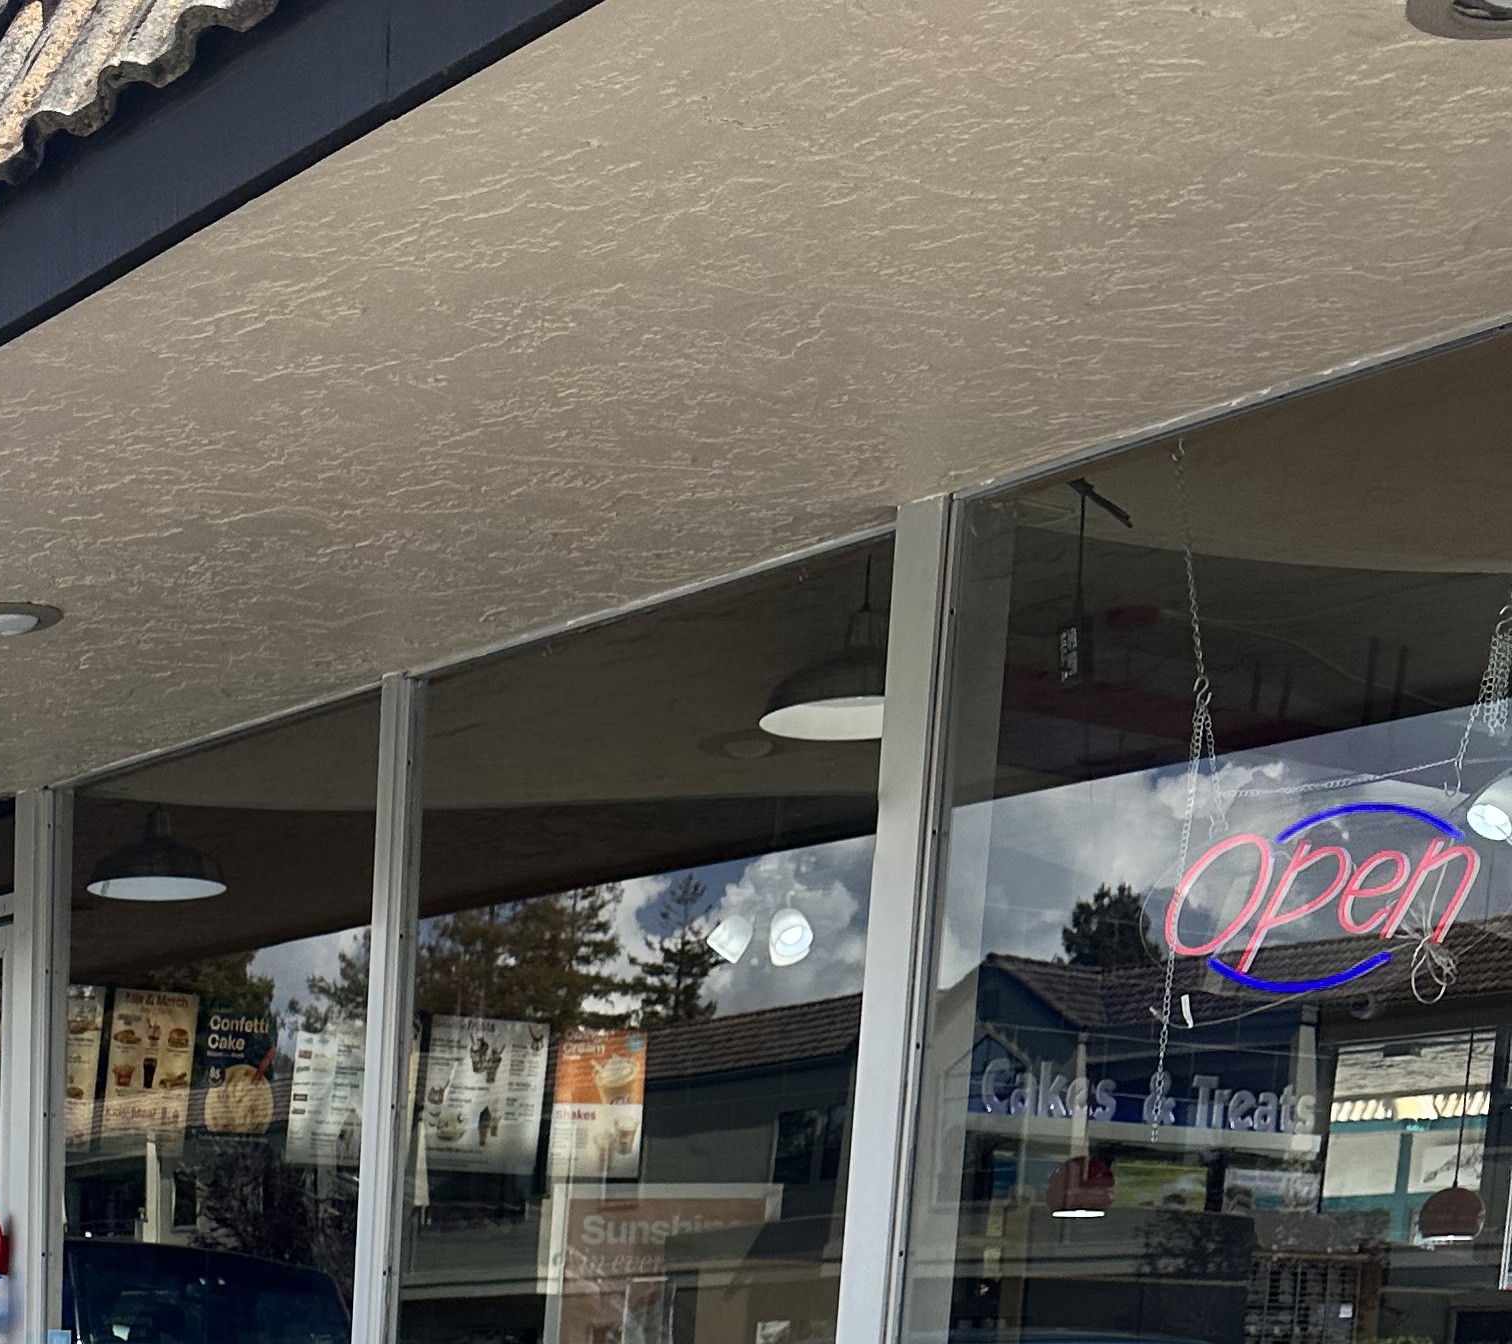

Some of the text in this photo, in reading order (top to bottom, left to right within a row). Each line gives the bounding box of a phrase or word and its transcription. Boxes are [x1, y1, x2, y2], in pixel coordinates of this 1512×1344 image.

[1165, 833, 1480, 976] Open
[209, 1014, 270, 1034] Confetti
[207, 1033, 246, 1051] Cake
[982, 1059, 1318, 1135] Cakes & Treats
[555, 1108, 596, 1121] Shakes
